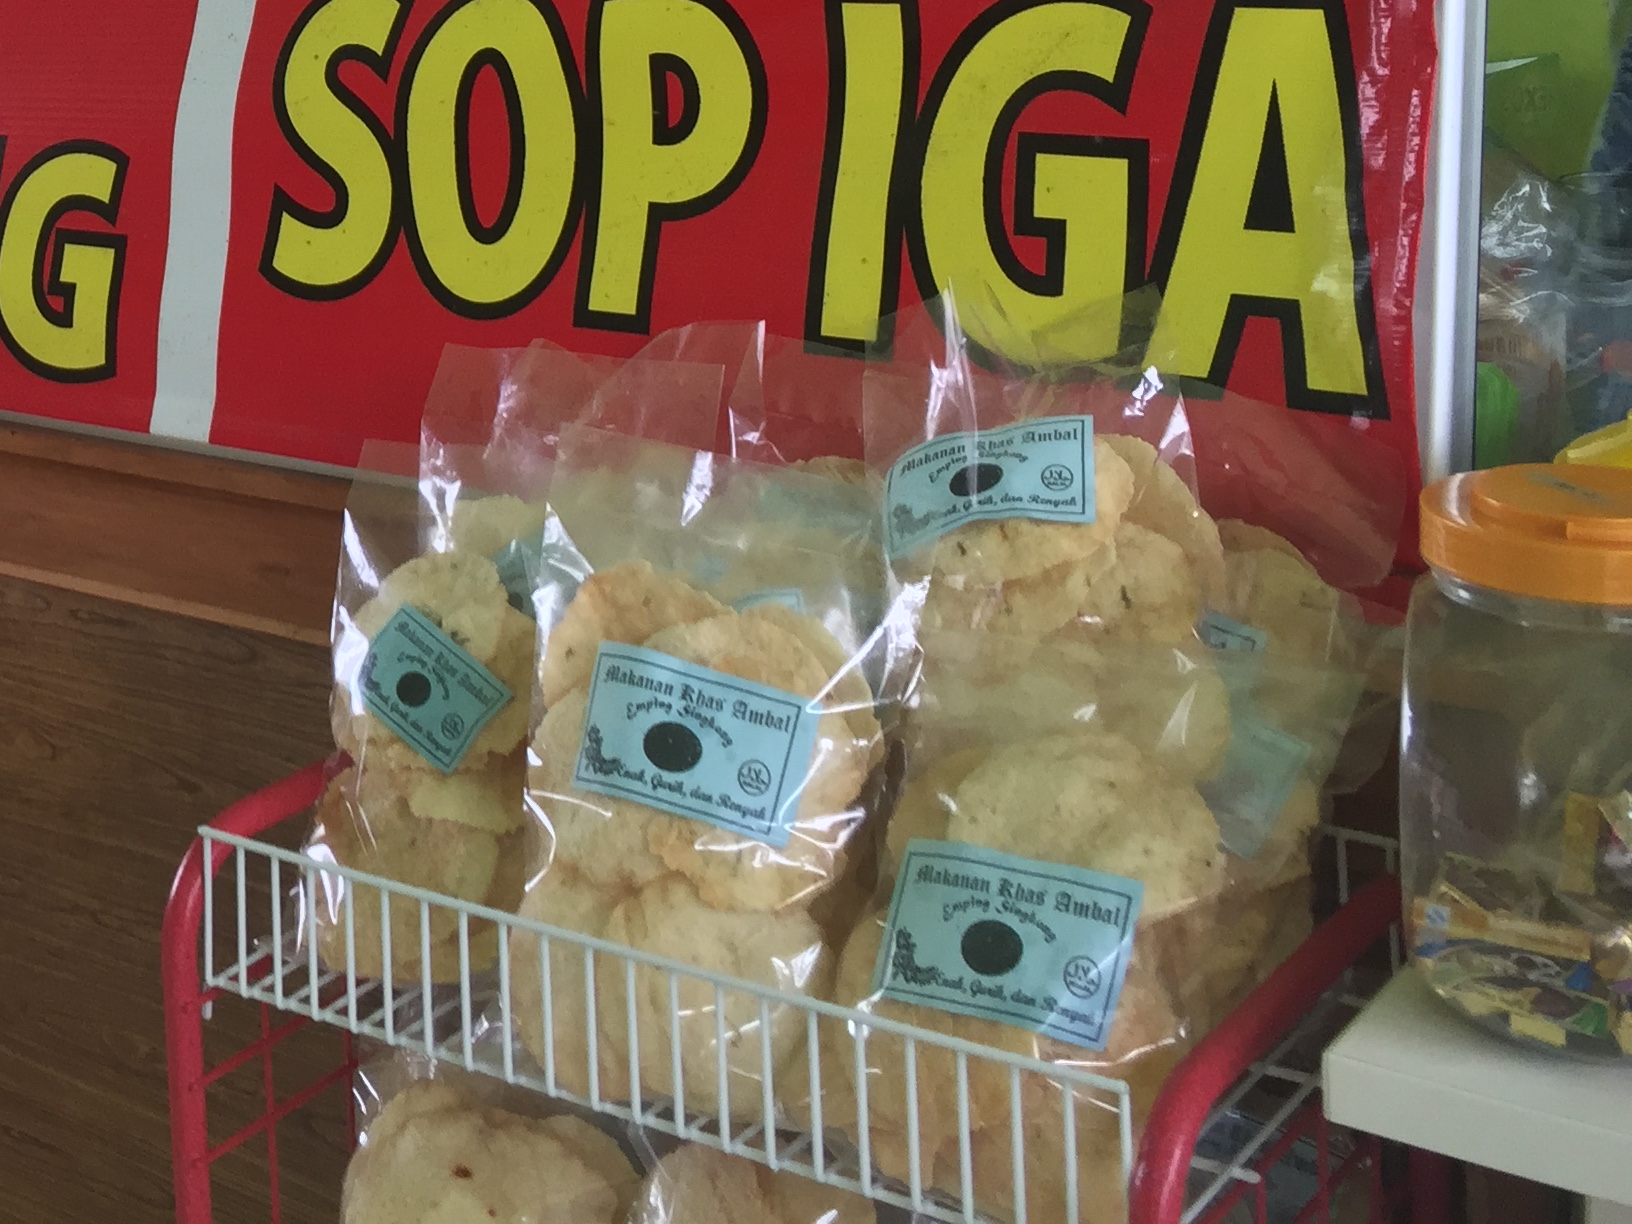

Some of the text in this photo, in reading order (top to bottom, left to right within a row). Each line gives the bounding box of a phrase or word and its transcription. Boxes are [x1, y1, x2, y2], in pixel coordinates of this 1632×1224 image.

[900, 444, 967, 476] Makanan
[1021, 428, 1079, 445] Ambal
[604, 665, 793, 734] Makanan Khas Ambal
[689, 784, 713, 804] dan
[914, 864, 1121, 926] Makanan Khas Ambal
[1010, 988, 1037, 1006] dan
